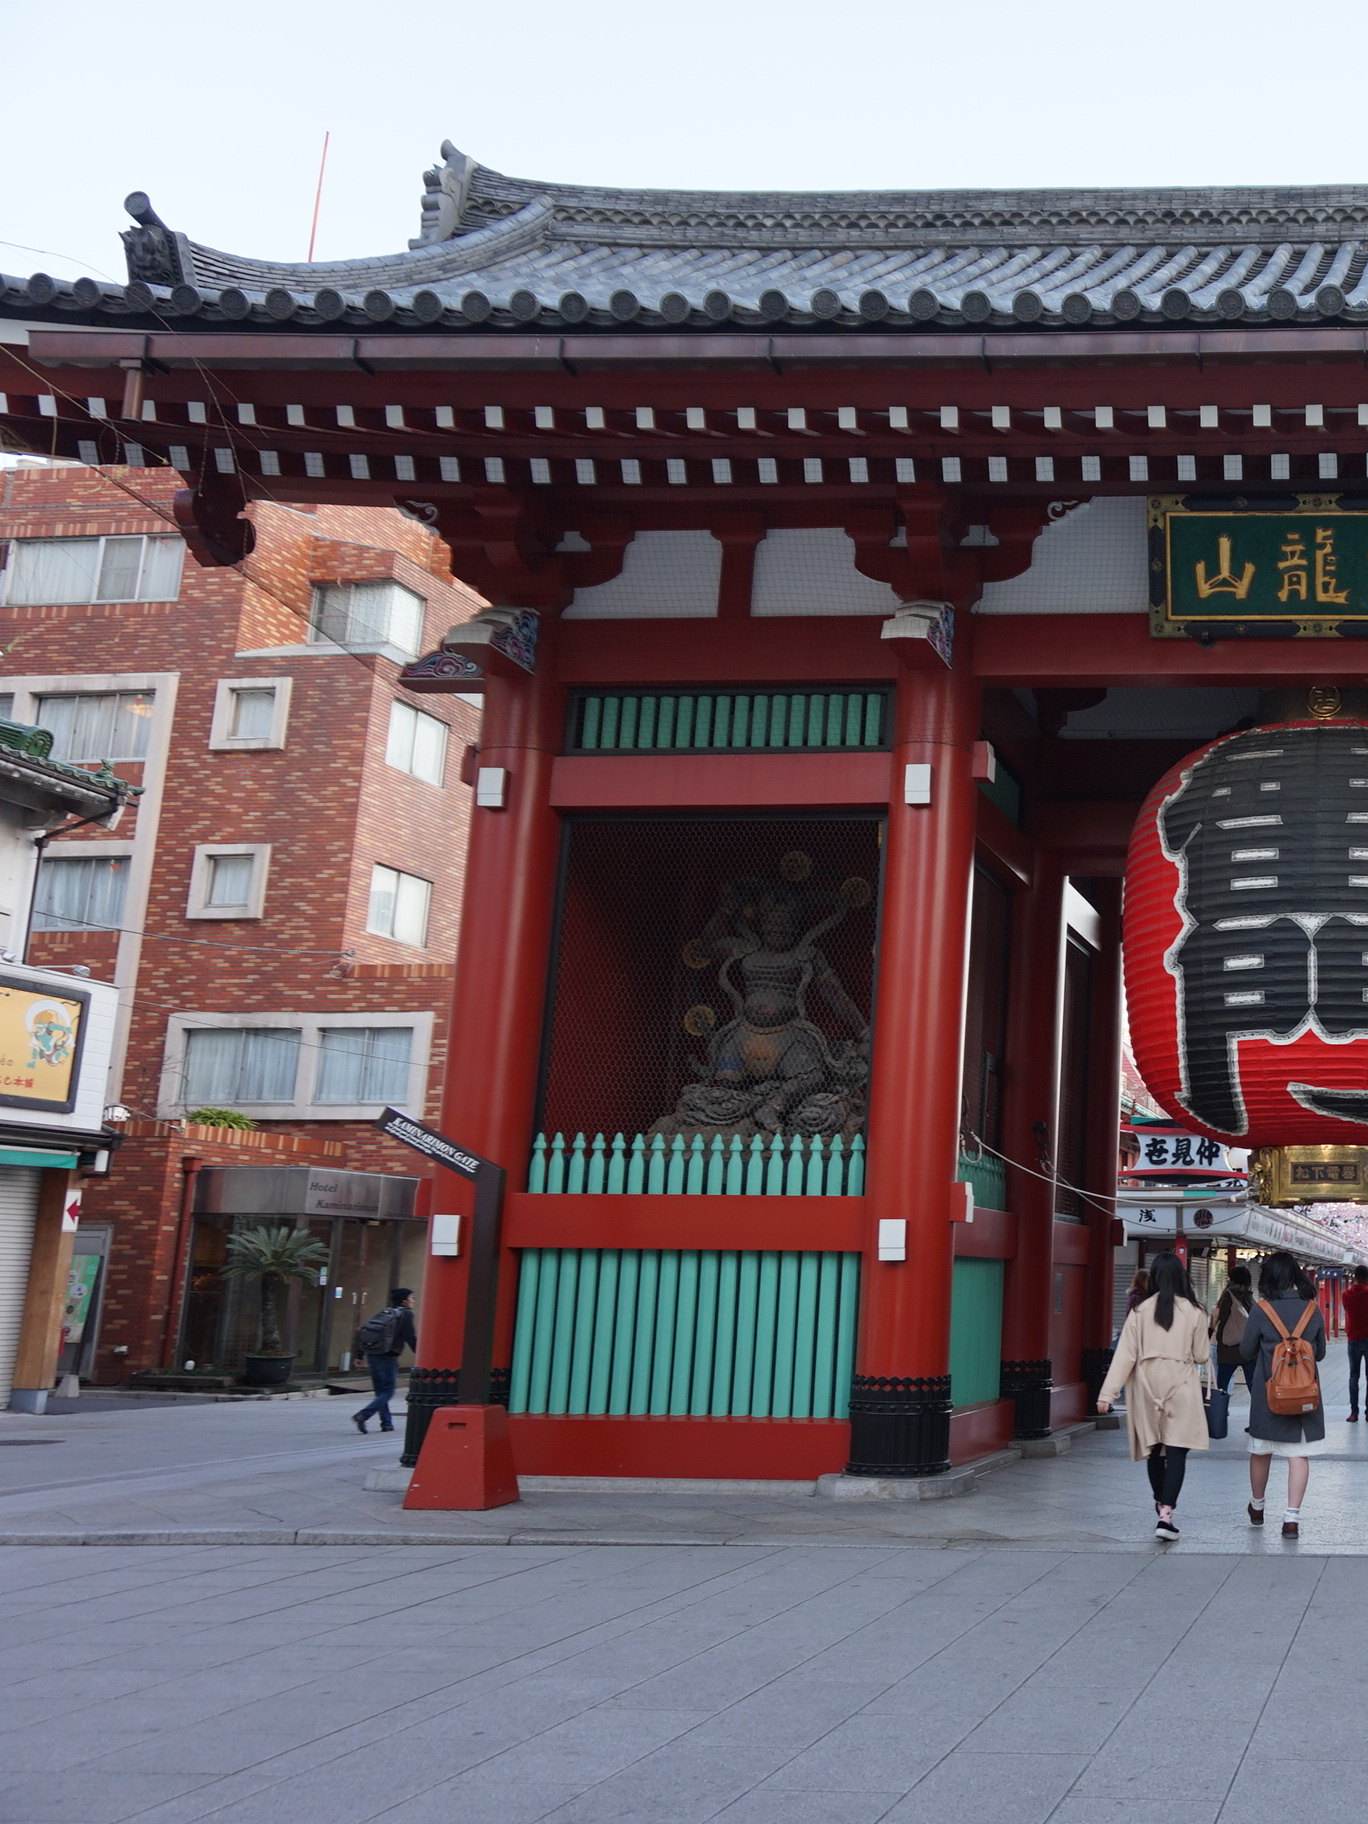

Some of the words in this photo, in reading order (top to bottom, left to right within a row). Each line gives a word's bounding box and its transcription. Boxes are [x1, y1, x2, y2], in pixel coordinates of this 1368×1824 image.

[392, 1117, 455, 1156] KAMINARIMON
[453, 1151, 480, 1170] GATE
[310, 1182, 338, 1193] Hotel
